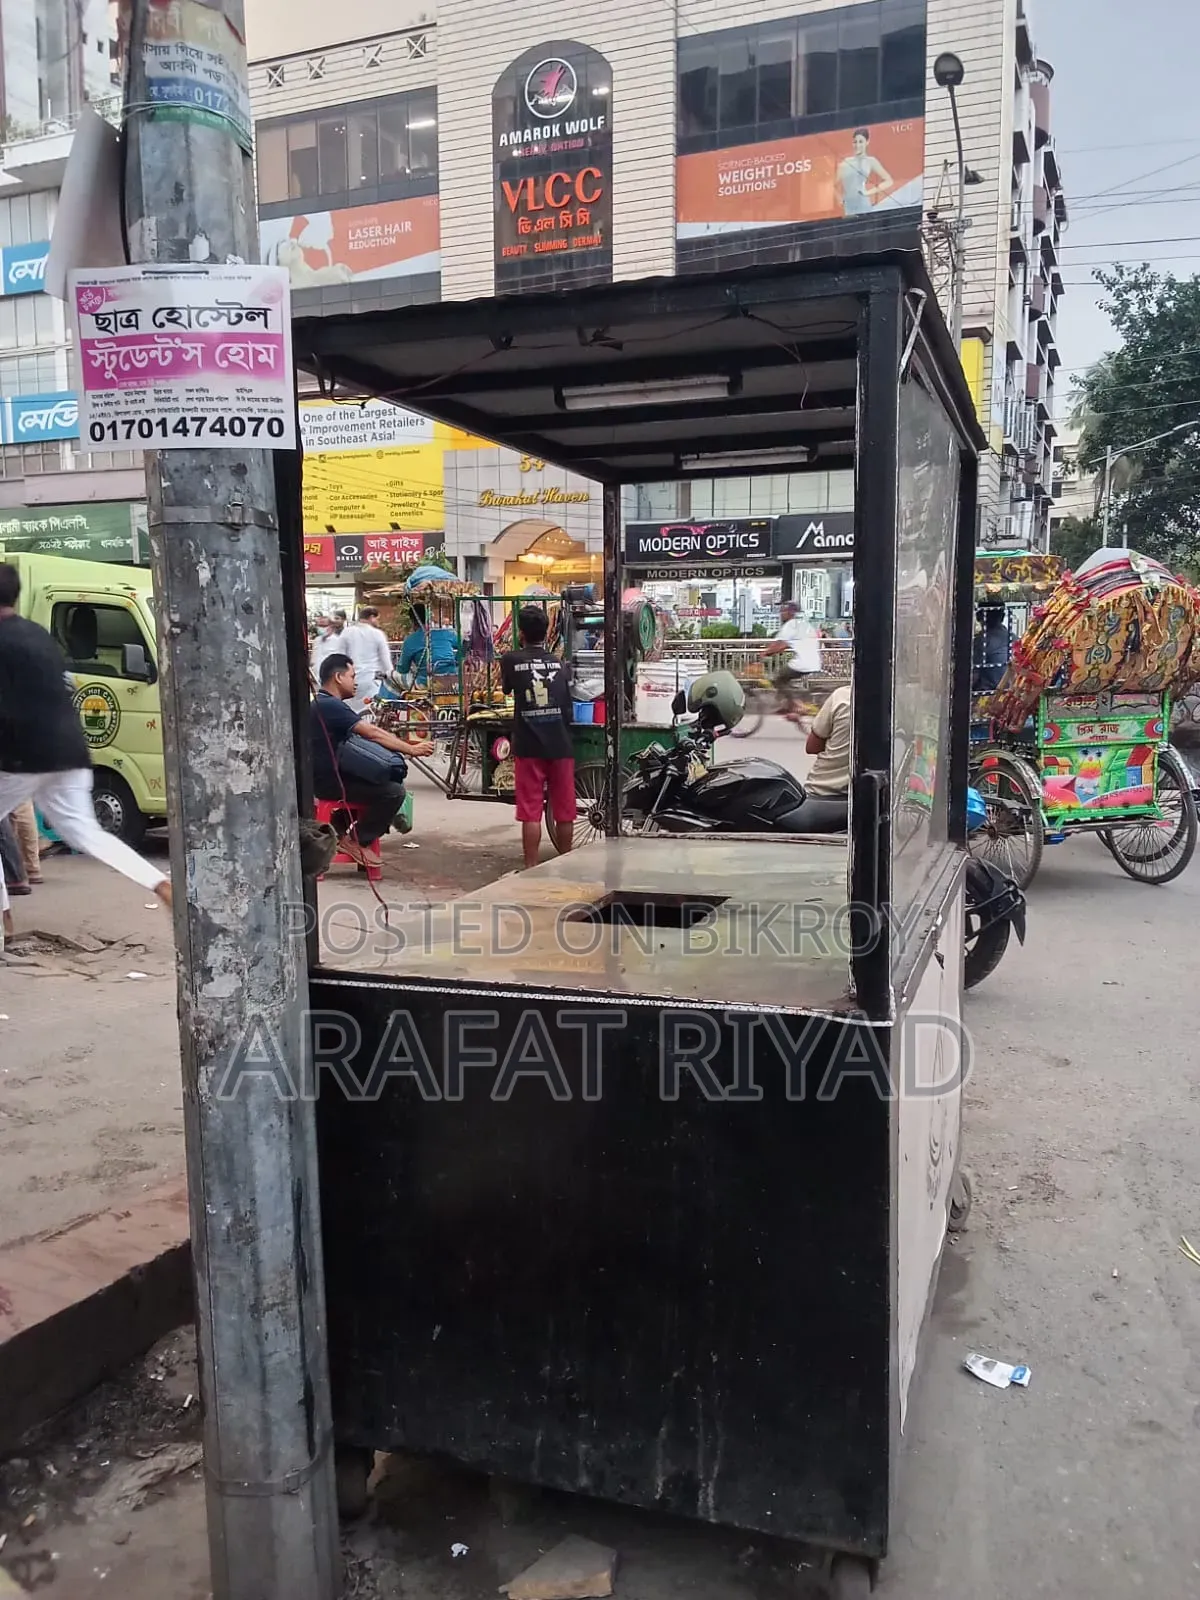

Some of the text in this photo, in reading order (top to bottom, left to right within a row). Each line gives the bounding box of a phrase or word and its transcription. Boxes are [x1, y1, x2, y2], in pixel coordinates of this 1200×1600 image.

[499, 116, 606, 147] AMAROK WOLF
[718, 159, 812, 185] WEIGHT LOSS
[501, 167, 603, 214] VLCC
[718, 179, 777, 196] SOLUTIONS
[348, 227, 382, 240] LASER
[384, 221, 412, 236] HAIR
[348, 236, 396, 250] REDUCTION
[502, 244, 528, 257] BEAUTY
[91, 299, 273, 336] ছাত্র হোস্টেল
[215, 340, 279, 371] হোম
[303, 407, 397, 423] One of the Largest
[90, 416, 285, 443] 01701474070
[309, 421, 376, 436] Improvement
[379, 417, 425, 429] Retailers
[305, 430, 396, 446] in Southeast Asia!
[367, 537, 388, 549] আই
[639, 533, 760, 553] MODERN OPTICS
[366, 551, 422, 563] EYE LIFE
[647, 567, 765, 579] MODERN OPTICS
